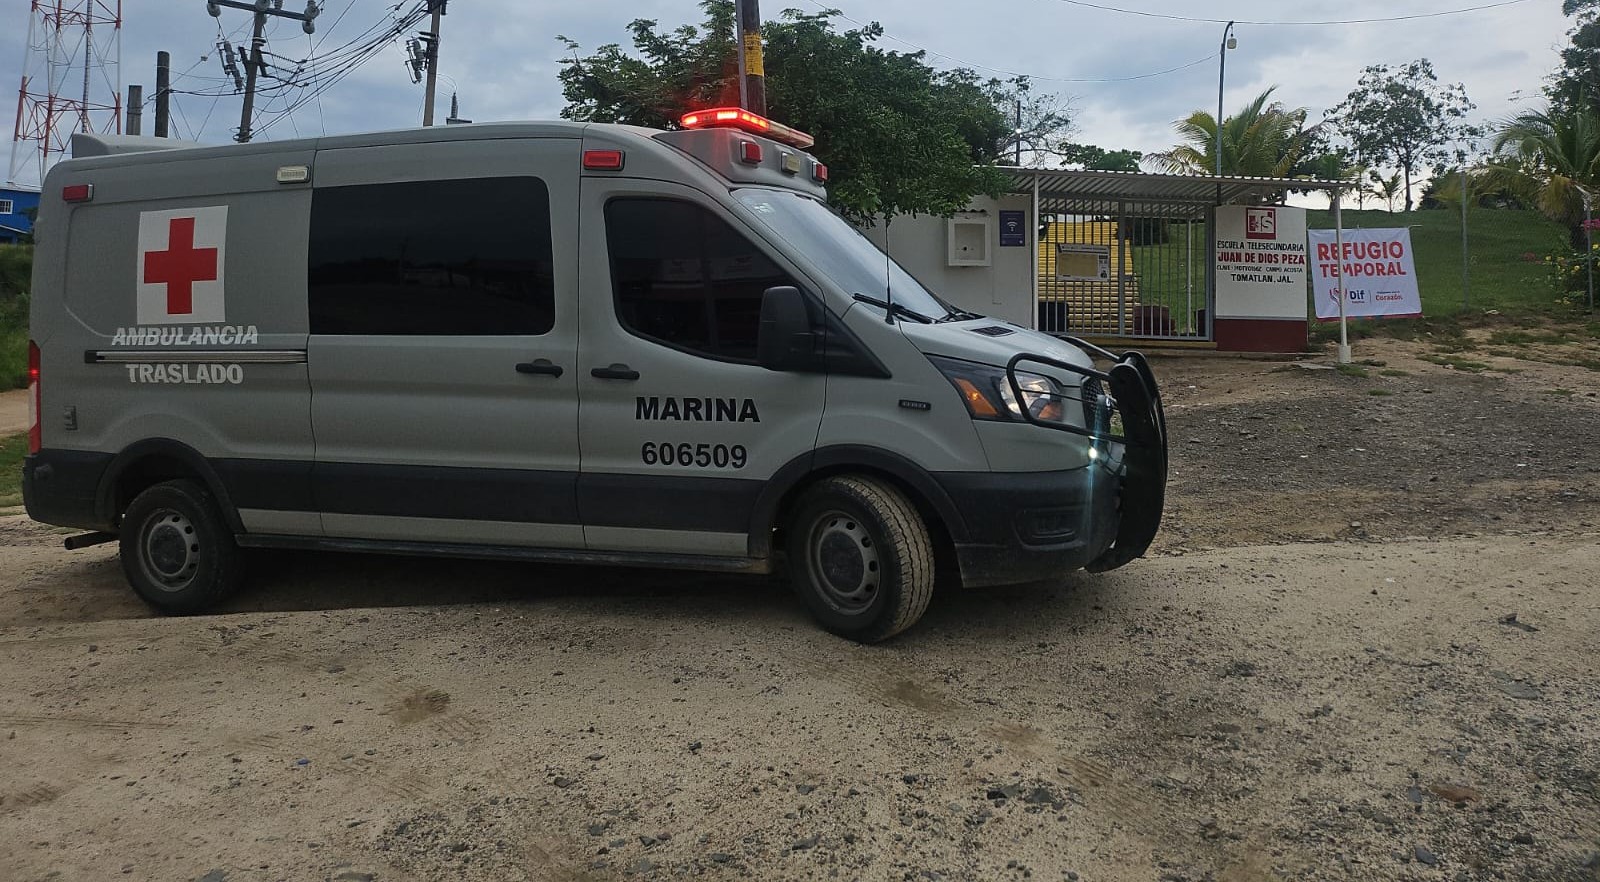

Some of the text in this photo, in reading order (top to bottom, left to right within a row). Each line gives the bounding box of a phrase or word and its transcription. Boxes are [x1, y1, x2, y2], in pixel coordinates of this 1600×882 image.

[1217, 241, 1304, 251] ESCUELA TELESECUNDARIA
[1317, 241, 1404, 261] REFUGIO
[1245, 253, 1256, 263] DE
[1258, 253, 1279, 264] DIOS
[1320, 262, 1407, 278] TEMPORAL
[1349, 290, 1365, 299] Dif
[112, 325, 258, 346] AMBULANCIA
[125, 364, 243, 384] TRASLADO
[635, 396, 760, 422] MARINA
[642, 442, 747, 469] 606509
